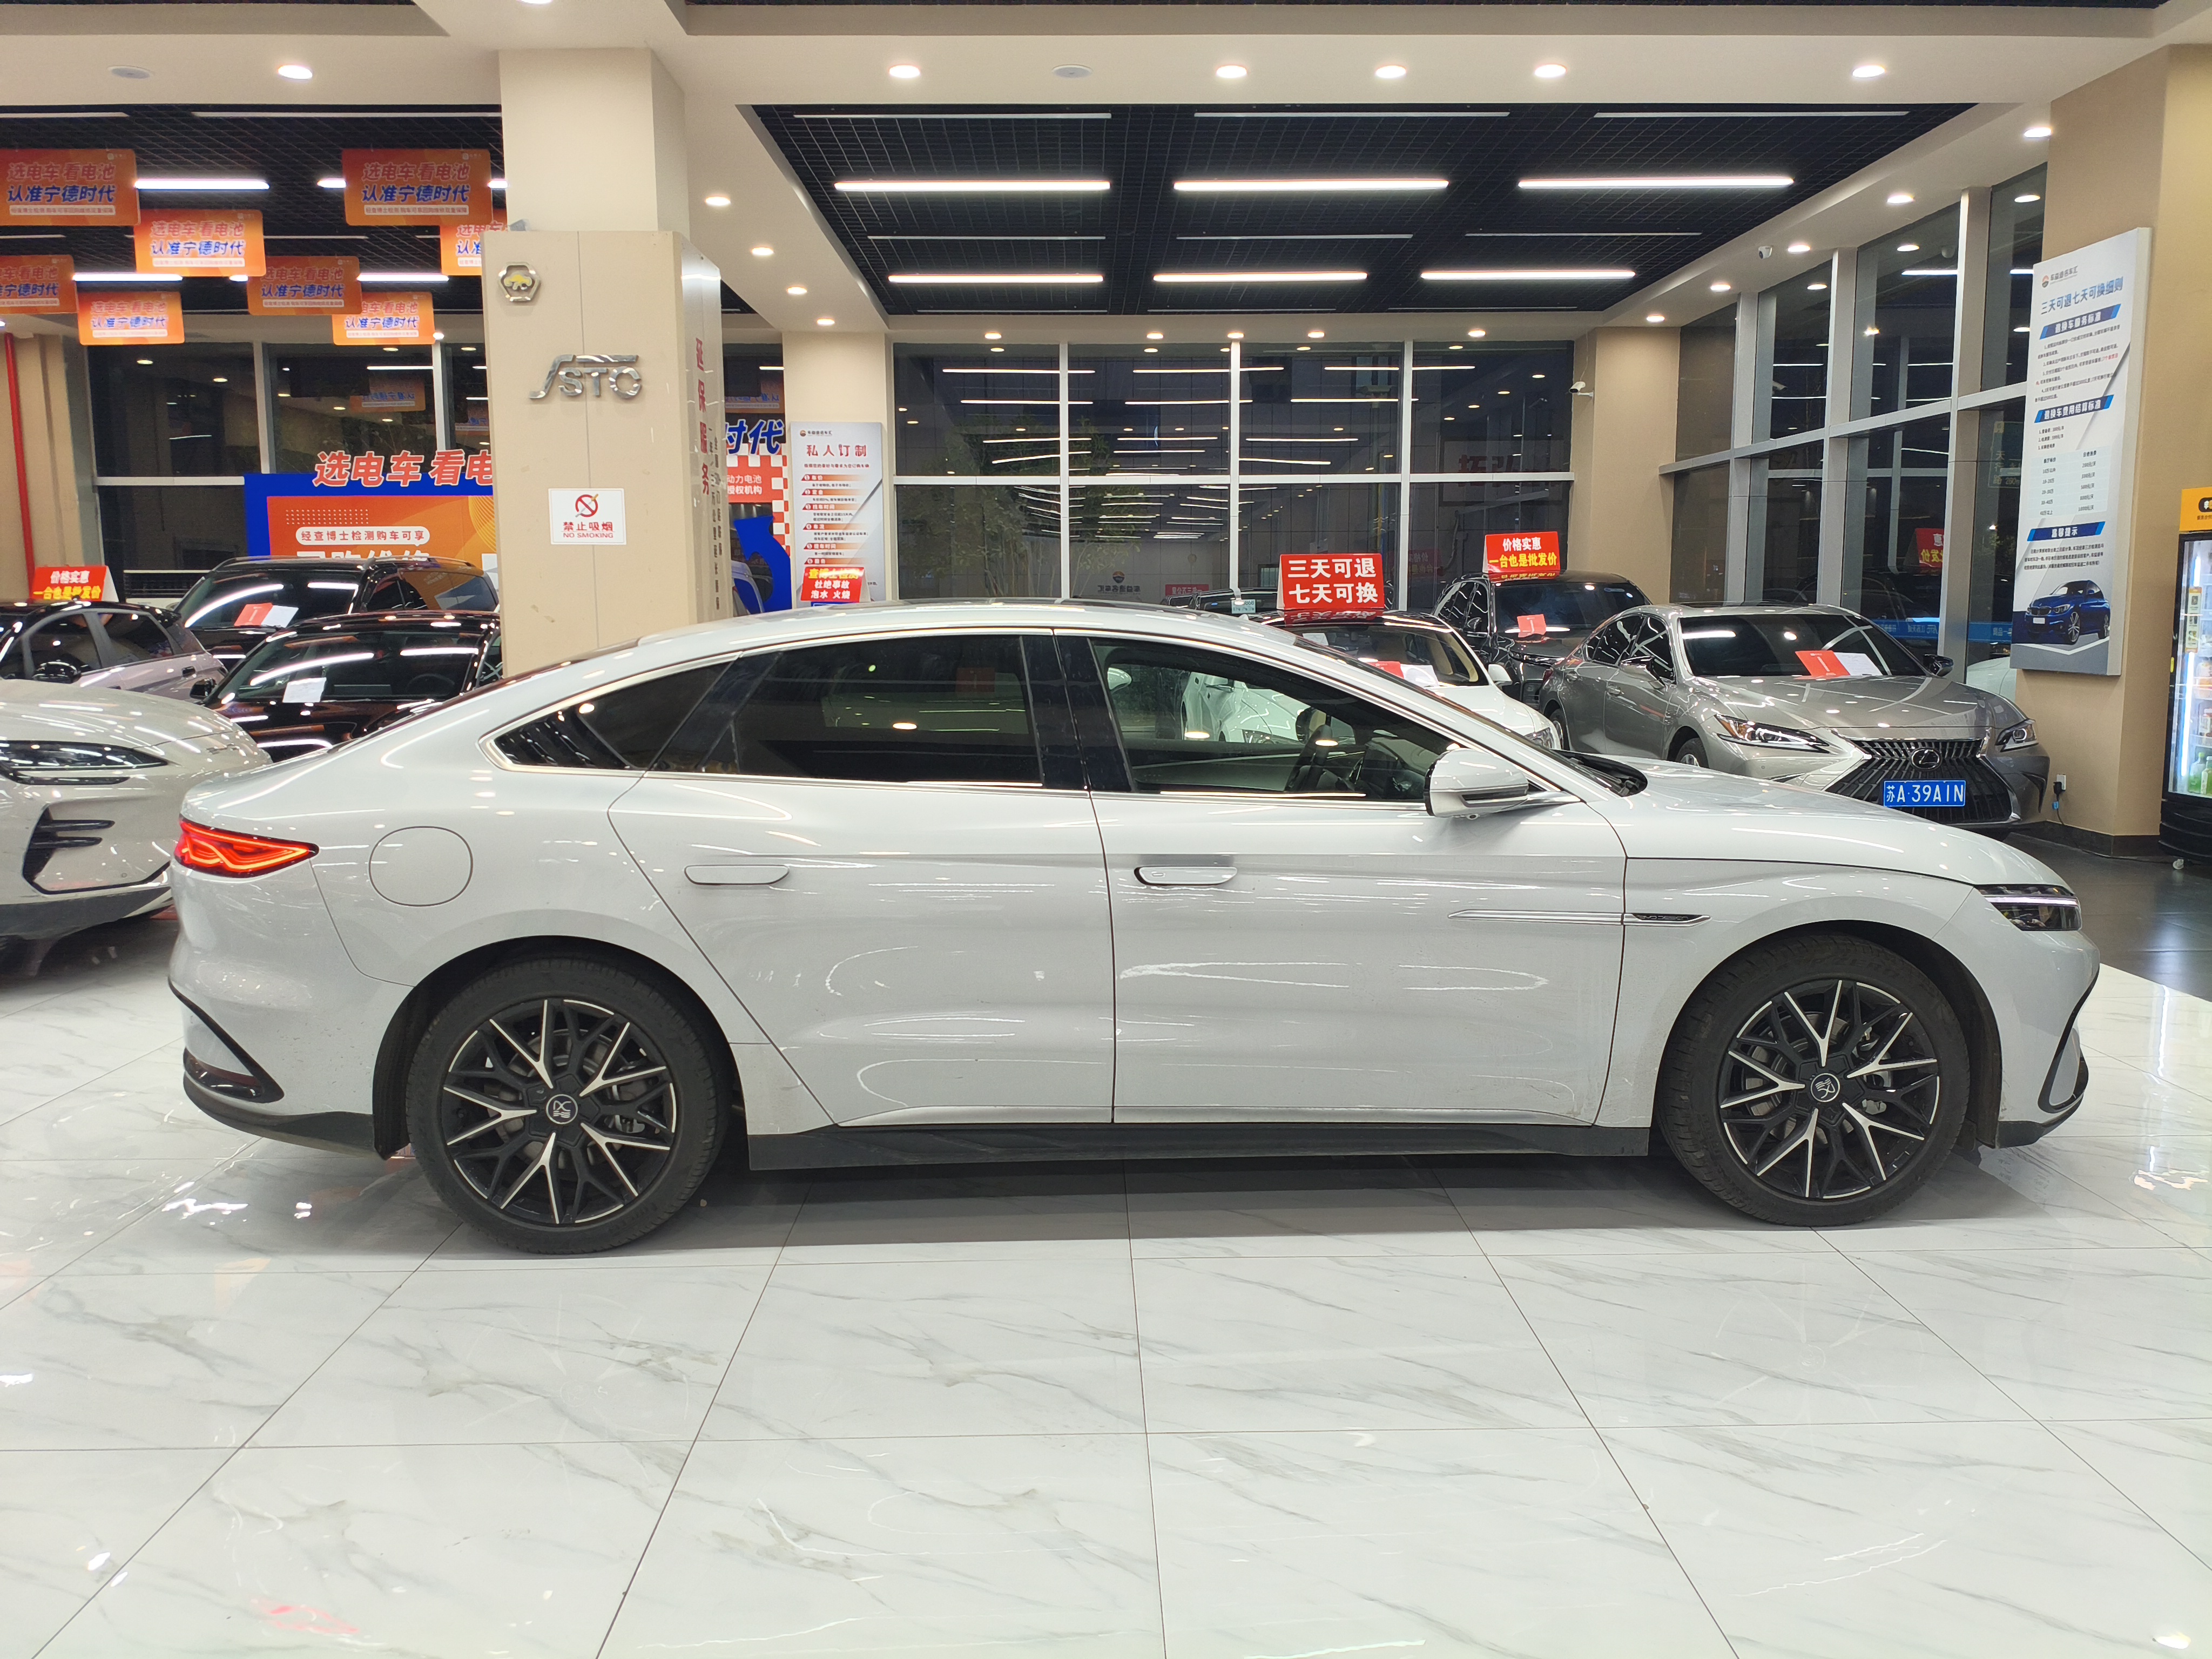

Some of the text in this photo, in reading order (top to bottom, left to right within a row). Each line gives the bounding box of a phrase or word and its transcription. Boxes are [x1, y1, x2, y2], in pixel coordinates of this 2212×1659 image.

[8, 184, 115, 203] 认准宁德时代
[361, 184, 470, 203] 认准宁德时代
[151, 240, 245, 257] 认准宁德时代
[261, 284, 345, 298] 认准宁德时代
[2041, 276, 2123, 315] 三天可退七天可换细则
[344, 318, 419, 331] 认准宁德时代
[806, 444, 867, 457] 私人订制
[563, 522, 613, 531] 禁止吸烟
[301, 530, 425, 541] 经查博士检测购车可享
[1502, 537, 1542, 552] 价格实惠
[1287, 557, 1377, 578] 三天可退
[1489, 552, 1557, 568] 一台也是批发价
[50, 570, 90, 584] 价格实惠
[814, 580, 850, 589] 杜绝事故
[33, 585, 102, 600] 一台也是批发价
[1289, 582, 1378, 603] 七天可换
